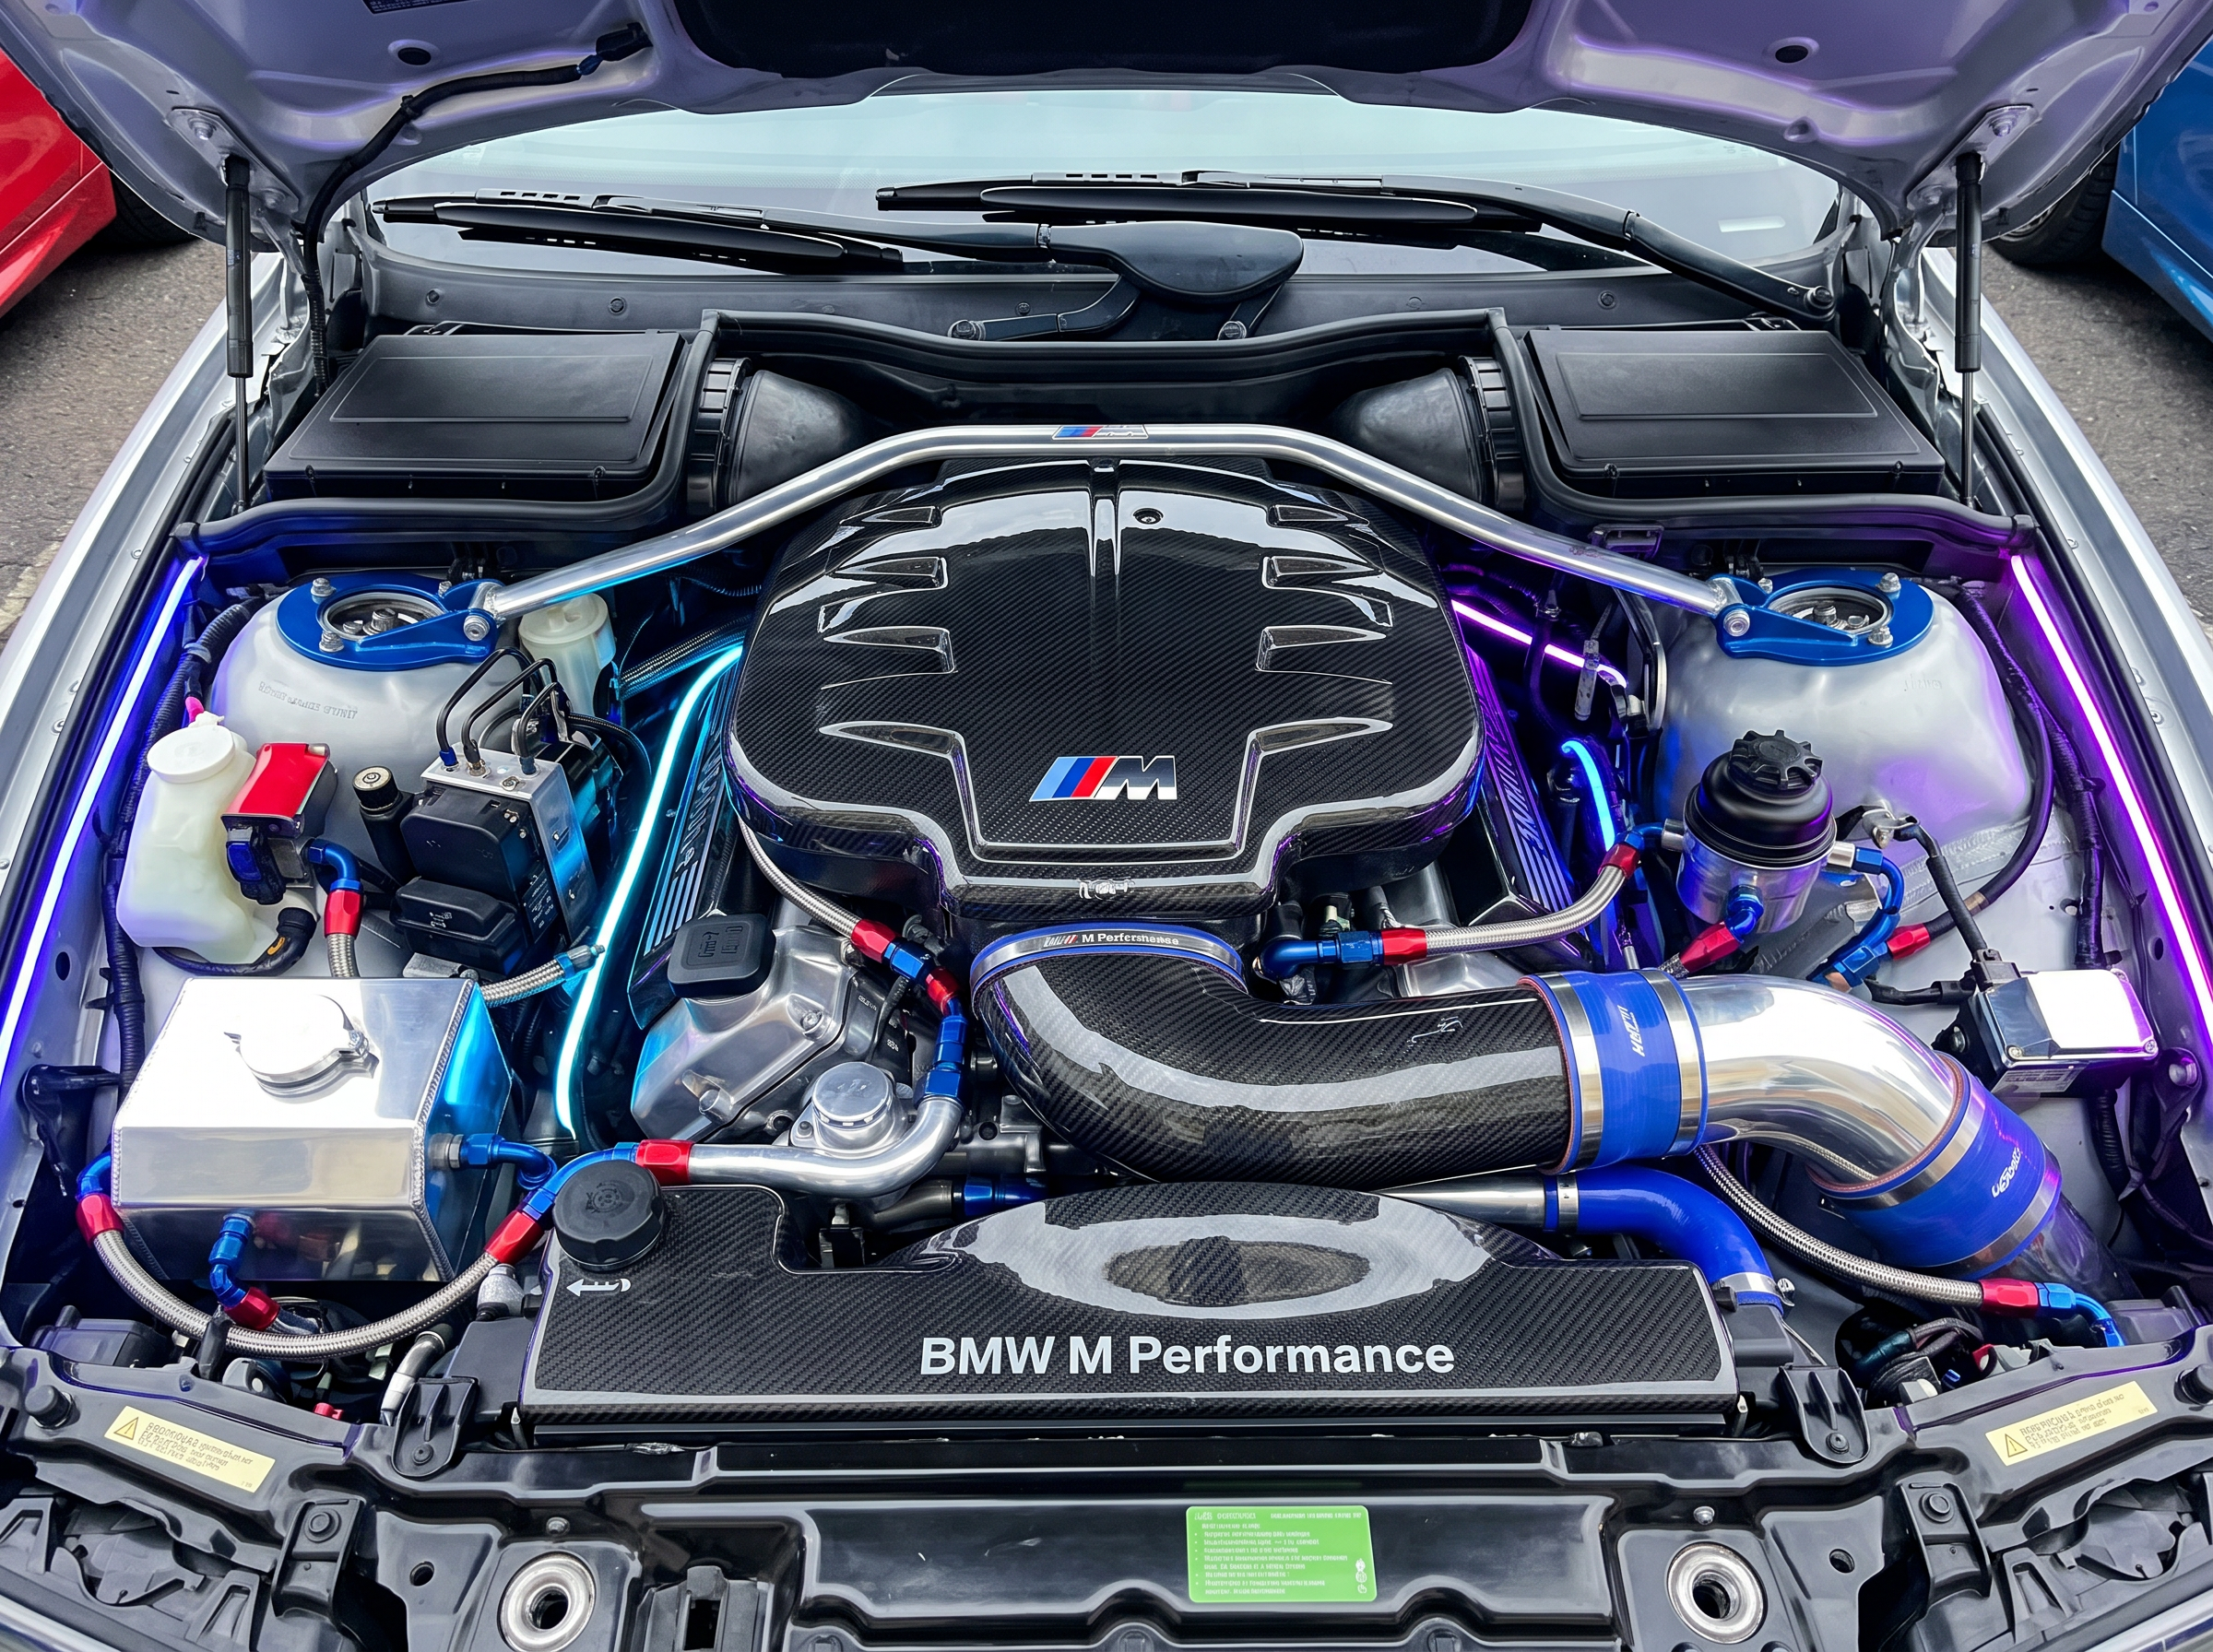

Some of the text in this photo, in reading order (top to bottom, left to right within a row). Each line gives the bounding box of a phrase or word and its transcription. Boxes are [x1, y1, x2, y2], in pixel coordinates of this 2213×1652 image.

[1094, 755, 1178, 800] M
[1082, 934, 1095, 943] M
[920, 1335, 1455, 1375] BMW M Performance
